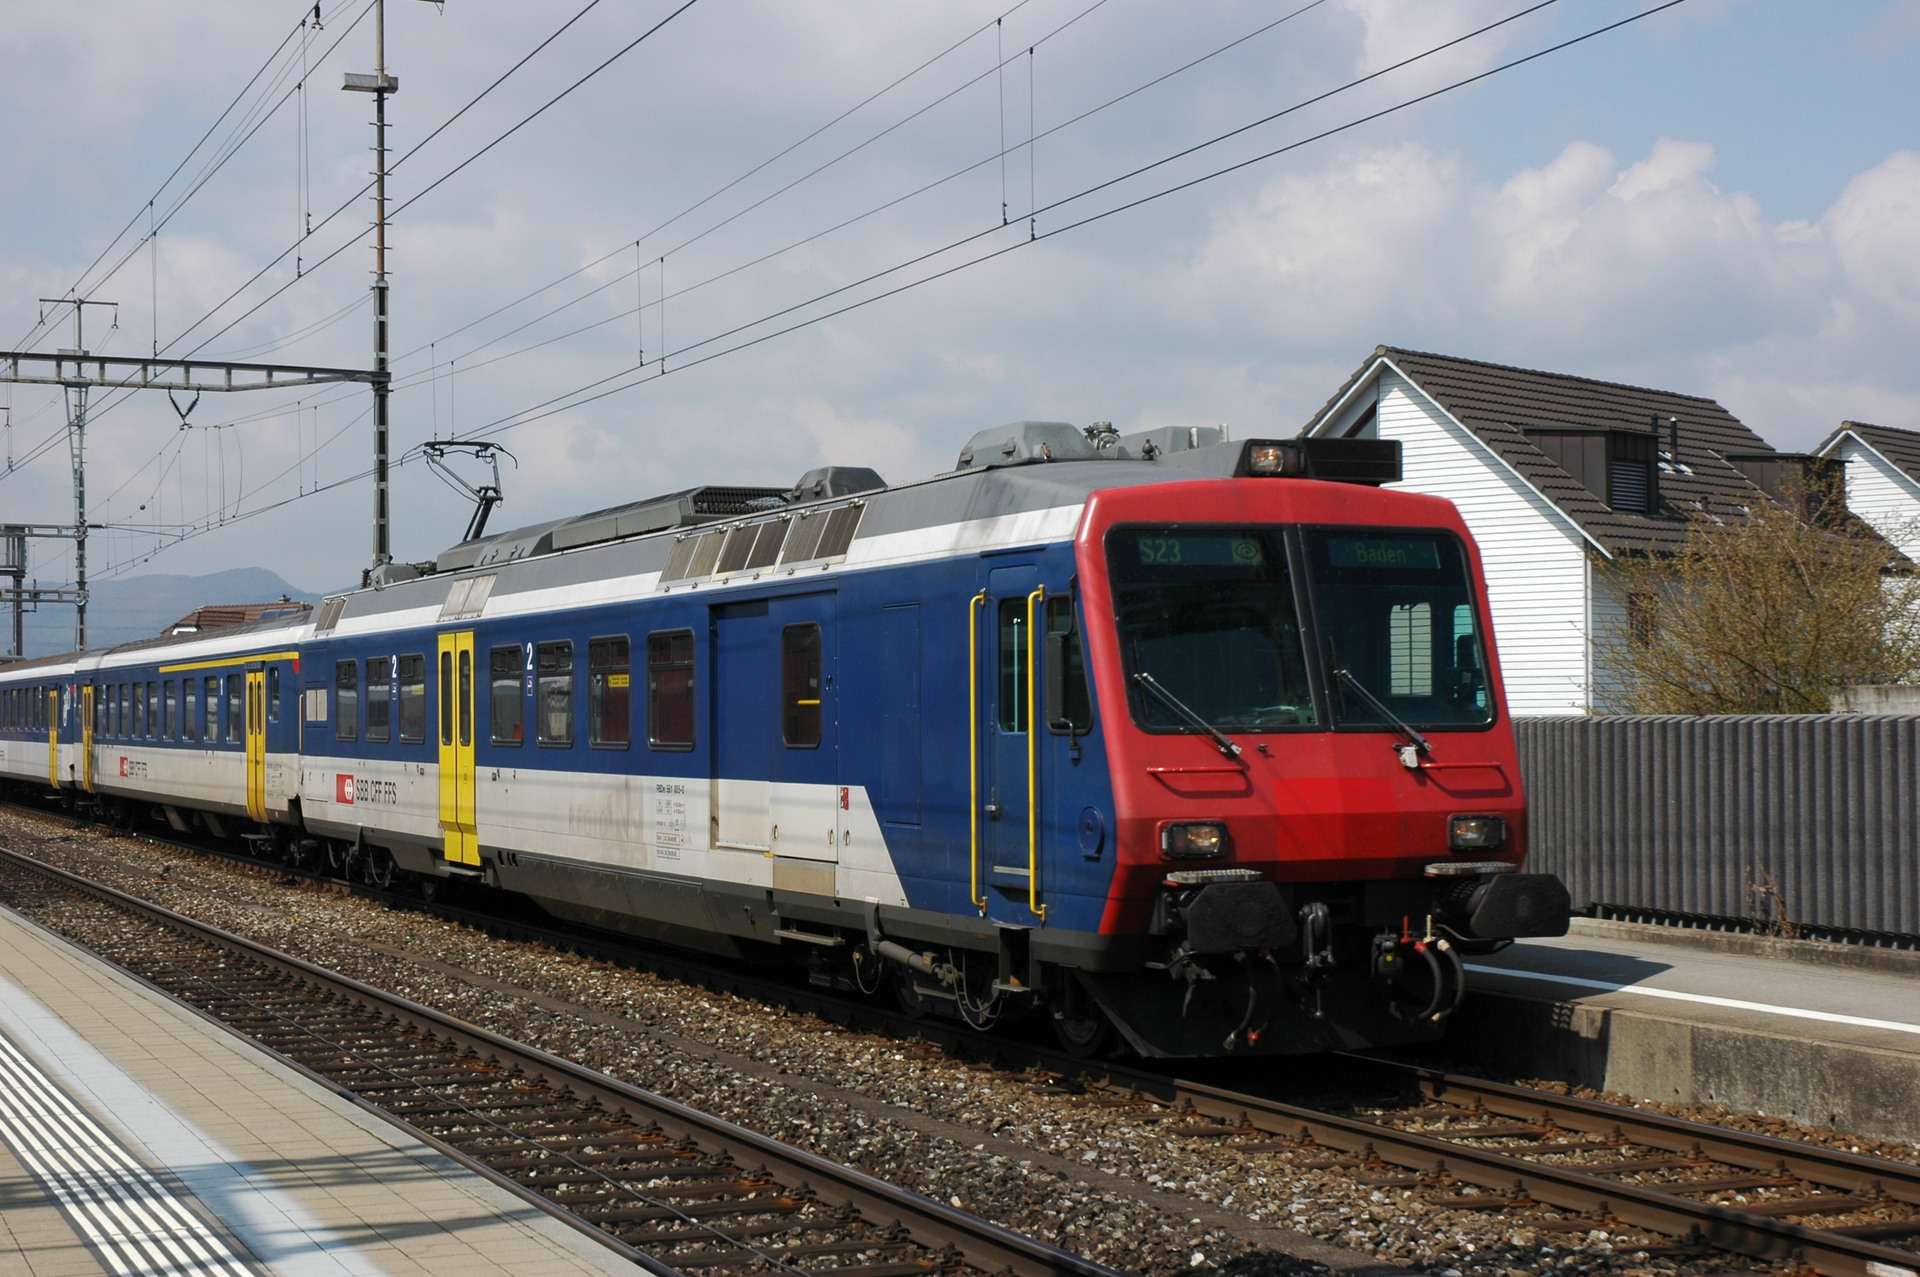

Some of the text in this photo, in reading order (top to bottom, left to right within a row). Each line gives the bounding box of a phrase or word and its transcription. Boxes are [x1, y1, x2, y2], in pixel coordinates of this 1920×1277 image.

[1138, 539, 1182, 563] S23
[1355, 541, 1406, 563] Baden
[391, 654, 397, 678] 2
[526, 641, 533, 670] 2
[356, 779, 397, 804] SBB CFF FFS
